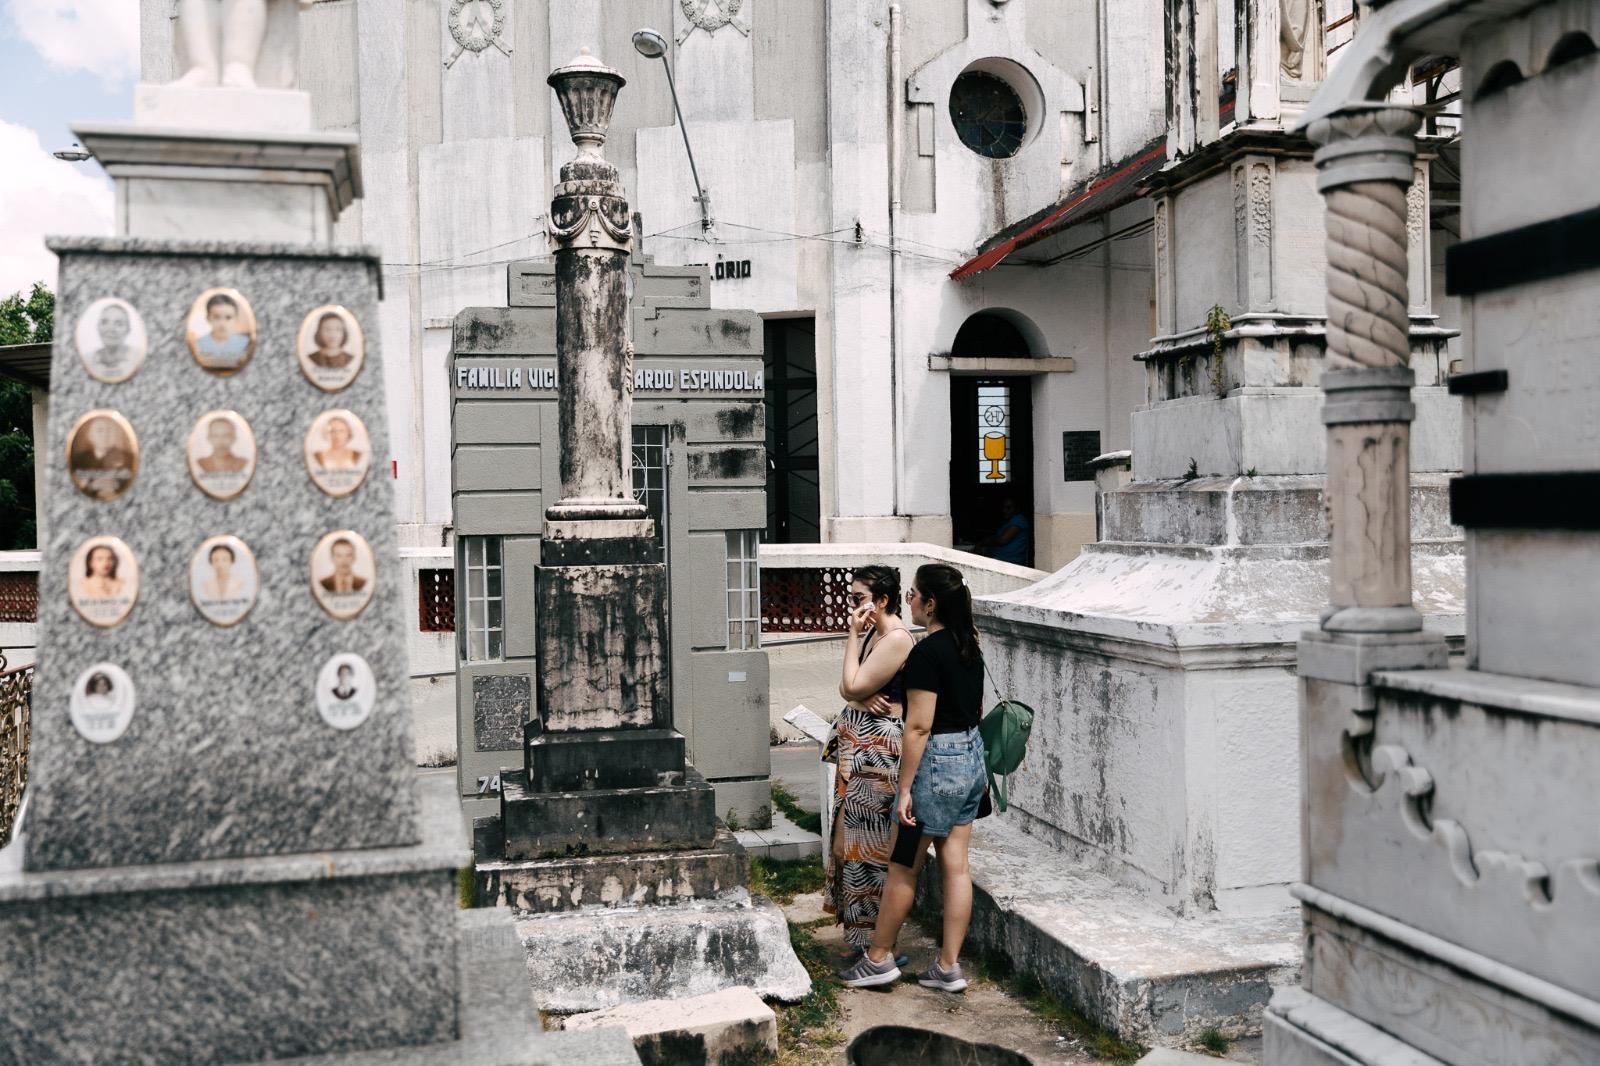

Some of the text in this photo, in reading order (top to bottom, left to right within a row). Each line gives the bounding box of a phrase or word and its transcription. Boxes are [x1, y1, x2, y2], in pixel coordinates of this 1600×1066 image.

[457, 367, 522, 388] FAMILIA
[634, 369, 674, 389] ARDO
[680, 370, 763, 390] ESPINDOLA
